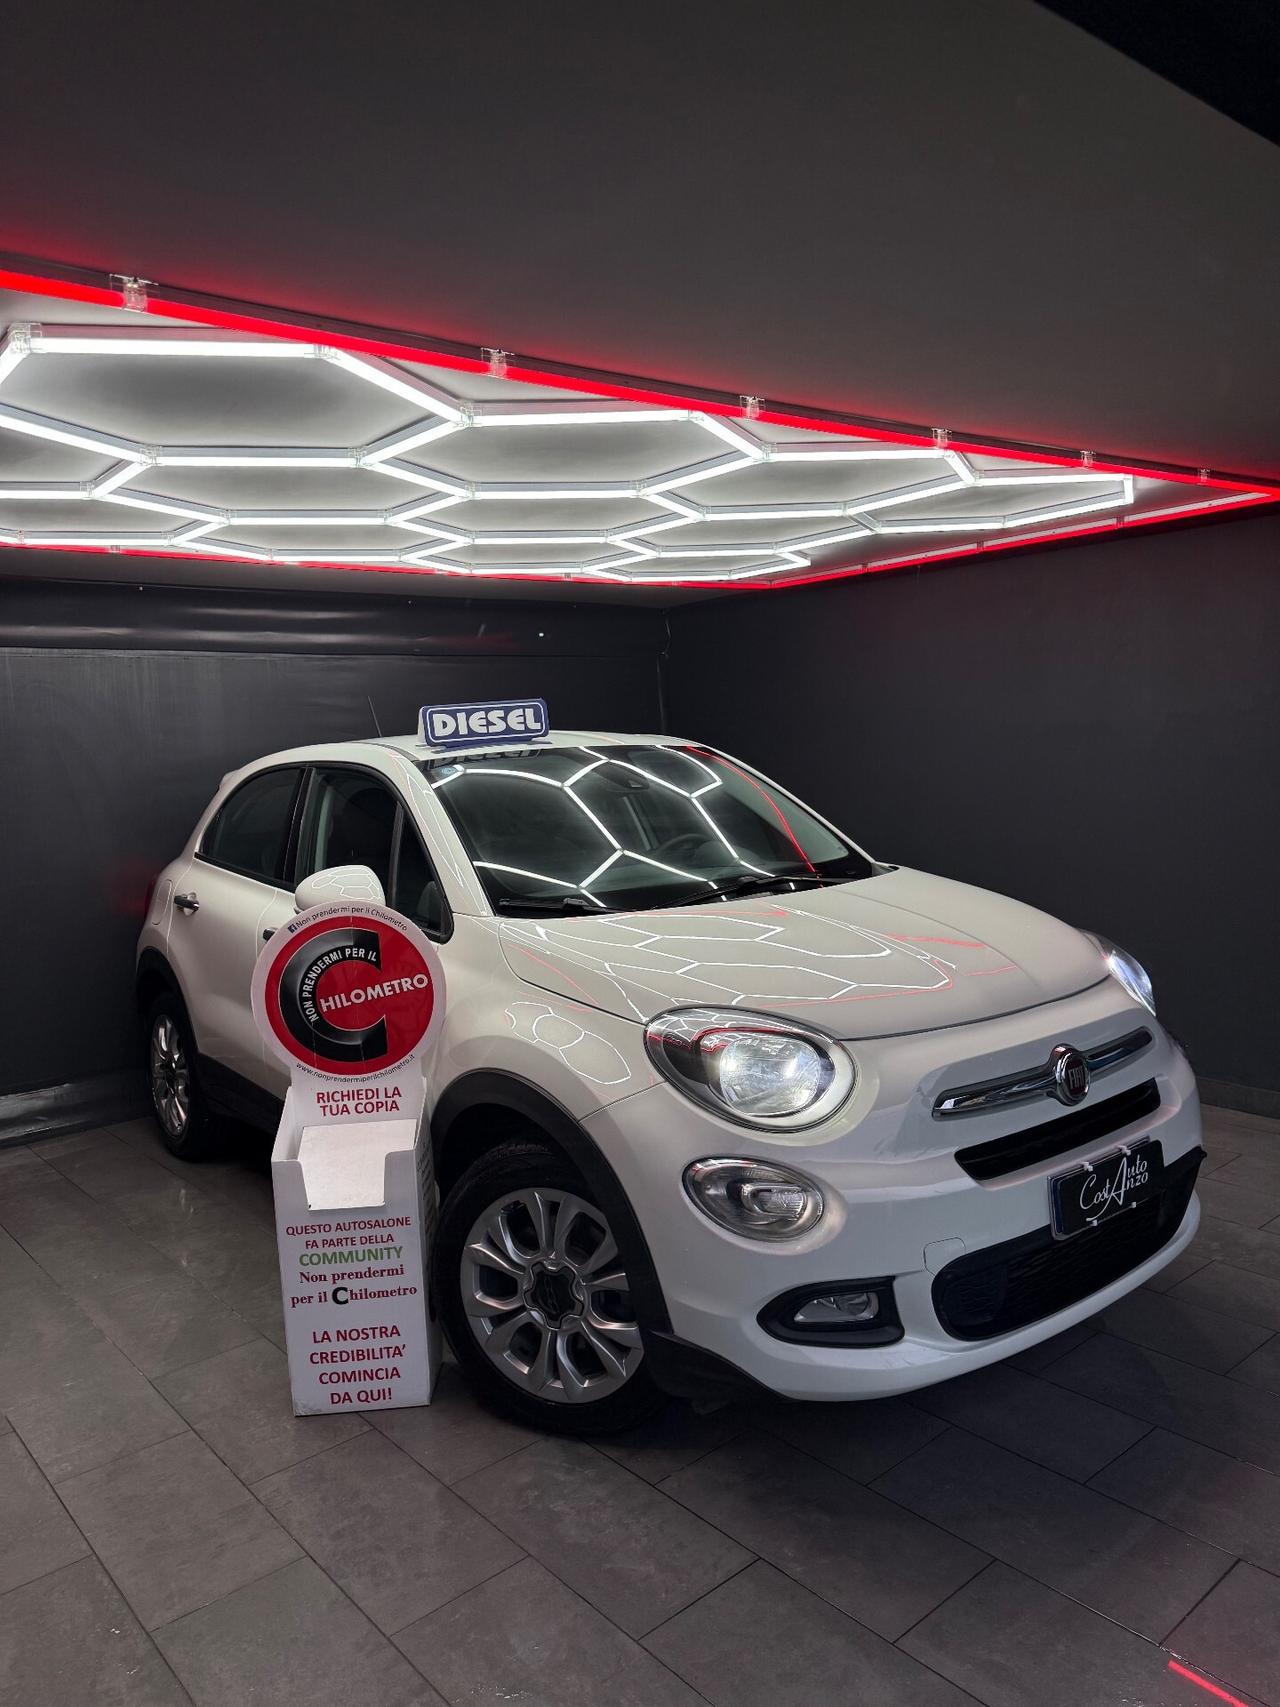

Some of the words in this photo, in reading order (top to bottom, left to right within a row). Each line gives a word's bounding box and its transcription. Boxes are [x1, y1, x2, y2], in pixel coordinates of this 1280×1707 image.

[432, 708, 541, 737] DIESEL
[295, 917, 311, 928] Non
[312, 905, 350, 920] prendermi
[351, 907, 364, 915] per
[371, 908, 407, 931] Chilometro
[345, 947, 365, 958] PER
[368, 951, 377, 962] IL
[302, 948, 343, 998] PRENDERMI
[302, 999, 319, 1022] NON
[296, 1054, 415, 1083] www.nonprendermiperilchilometro.it
[1068, 1065, 1085, 1090] FIAT
[316, 1087, 379, 1104] RICHIEDI
[384, 1086, 402, 1099] LA
[320, 1103, 350, 1117] TUA
[354, 1100, 400, 1114] COPIA
[286, 1223, 332, 1236] QUESTO
[335, 1216, 411, 1232] AUTOSALONE
[305, 1240, 319, 1249] FA
[322, 1236, 356, 1248] PARTE
[360, 1233, 394, 1245] DELLA
[299, 1246, 403, 1266] COMMUNITY
[299, 1271, 328, 1283] Non
[332, 1264, 405, 1284] prendermi
[291, 1295, 314, 1308] per
[318, 1291, 328, 1303] il
[332, 1285, 417, 1305] Chilometro
[312, 1331, 332, 1344] LA
[336, 1325, 401, 1341] NOSTRA
[319, 1366, 401, 1385] COMINCIA
[330, 1392, 352, 1405] DA
[357, 1387, 392, 1404] QUI!
